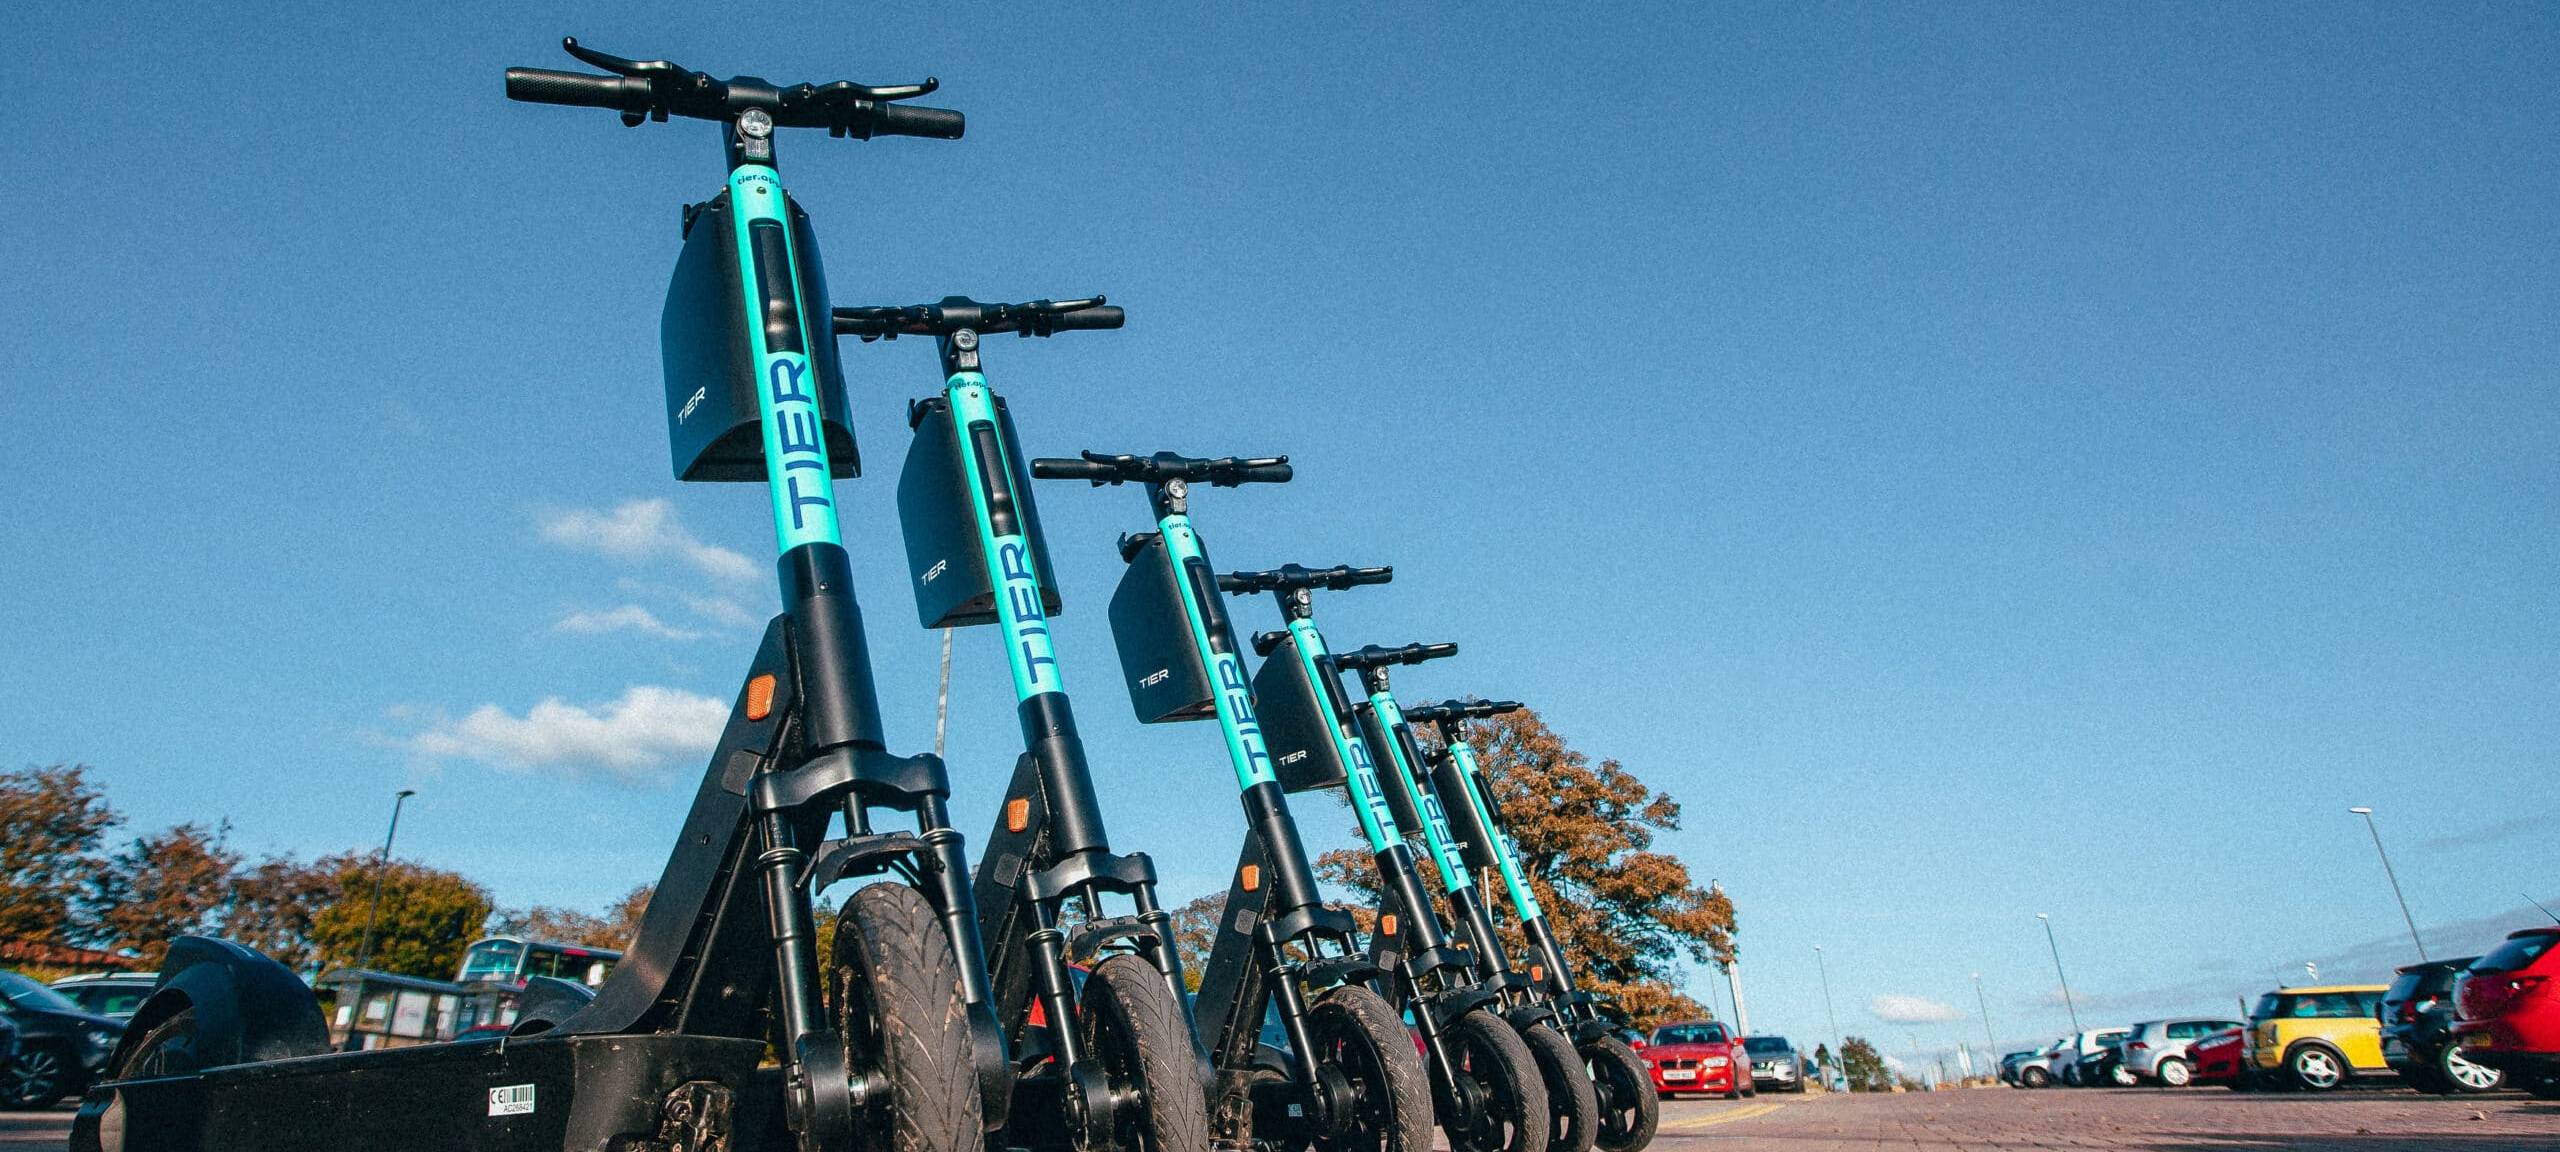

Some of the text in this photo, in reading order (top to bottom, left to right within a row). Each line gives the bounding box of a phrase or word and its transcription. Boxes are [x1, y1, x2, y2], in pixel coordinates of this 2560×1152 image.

[677, 386, 705, 425] TIER
[770, 358, 831, 530] TIER
[921, 559, 947, 586] TIER
[1000, 543, 1055, 685] TIER
[1138, 669, 1169, 689] TIER
[1219, 659, 1268, 774] TIER
[1279, 749, 1307, 767] TIER
[1350, 743, 1395, 841] TIER
[1424, 797, 1464, 881] TIER
[1455, 841, 1468, 850] ER
[490, 1089, 504, 1104] CE
